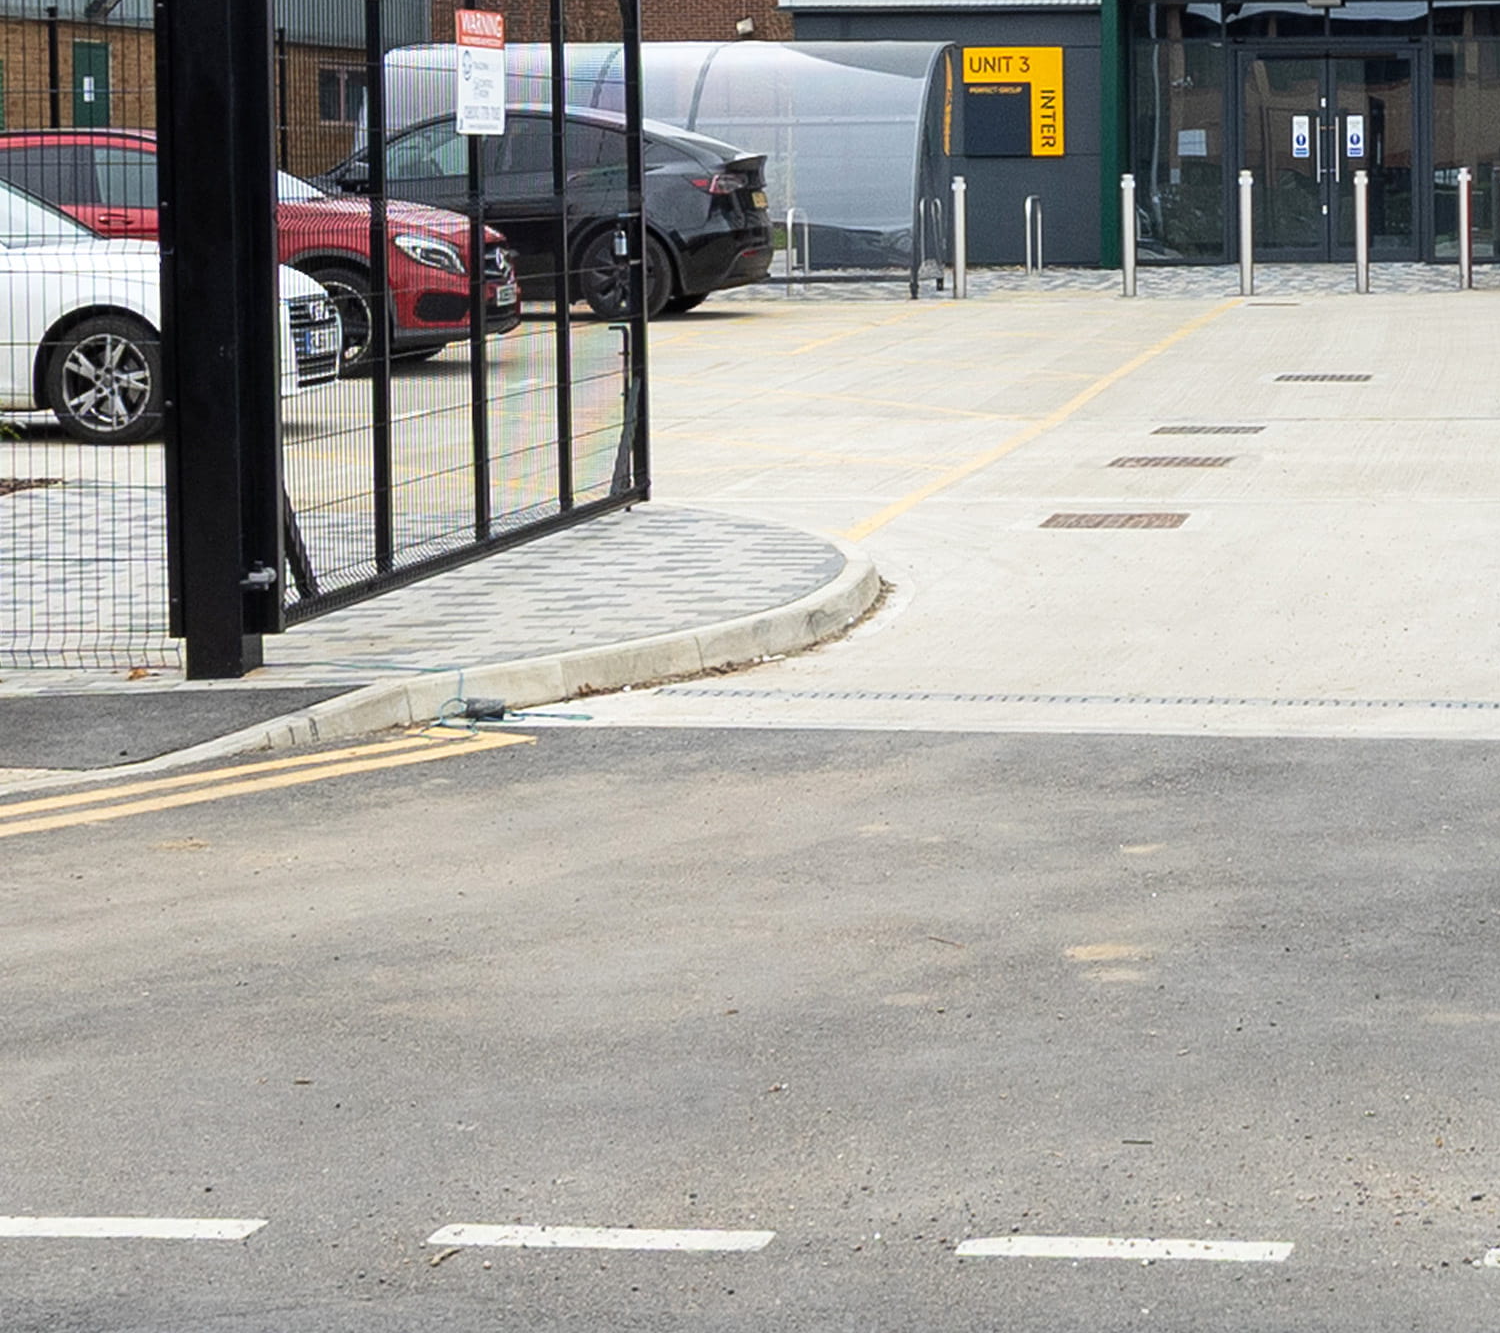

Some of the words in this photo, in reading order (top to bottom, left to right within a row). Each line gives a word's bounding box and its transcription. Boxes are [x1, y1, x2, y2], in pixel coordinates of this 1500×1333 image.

[969, 56, 1013, 73] UNIT
[1019, 56, 1031, 73] 3
[1040, 89, 1056, 148] INTER
